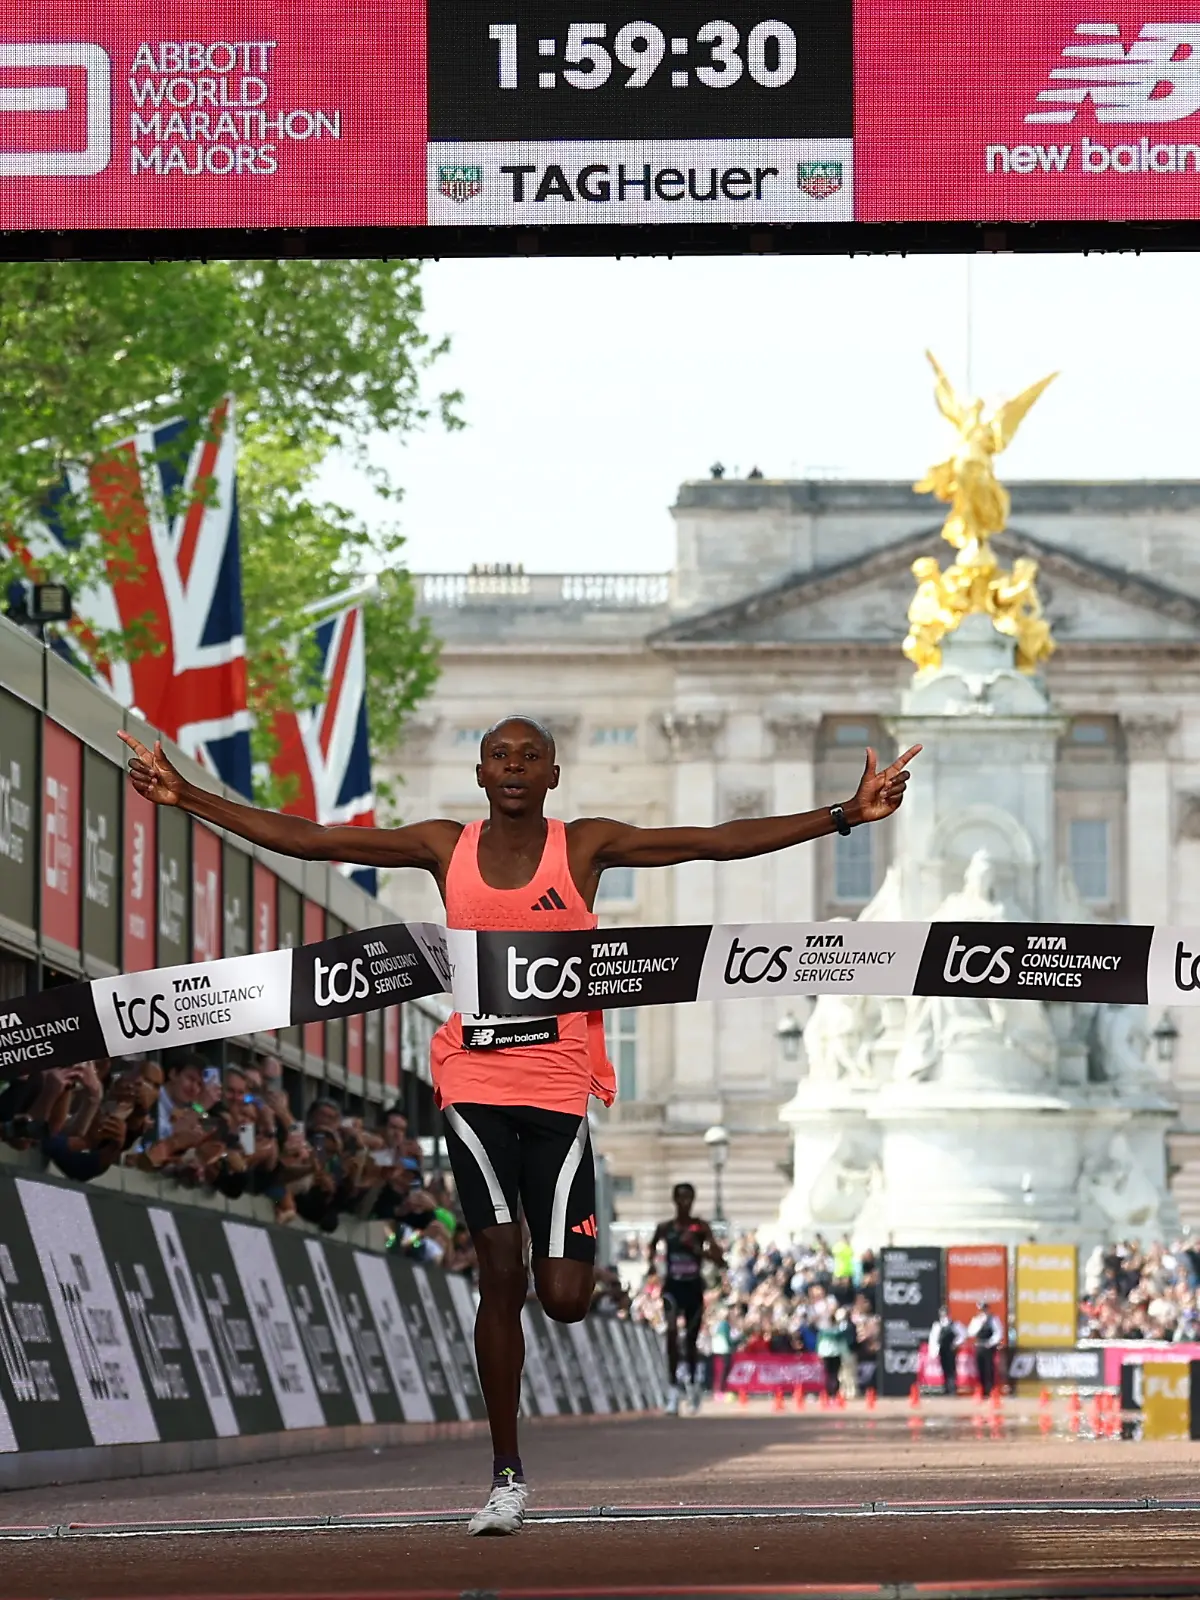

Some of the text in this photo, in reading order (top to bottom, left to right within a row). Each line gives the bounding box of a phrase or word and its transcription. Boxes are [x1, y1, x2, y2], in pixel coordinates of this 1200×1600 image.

[130, 41, 279, 74] ABBOTT
[488, 20, 797, 88] 1:59:30
[128, 76, 269, 108] WORLD
[130, 109, 341, 141] MARATHON
[131, 144, 279, 175] MAJORS
[985, 144, 1072, 174] new
[363, 941, 388, 957] TATA
[591, 942, 628, 958] TATA
[805, 935, 844, 948] TATA
[1027, 936, 1067, 950] TATA
[370, 953, 419, 975] CONSULTANCY
[589, 957, 680, 977] CONSULTANCY
[724, 937, 793, 985] tcs
[799, 951, 896, 965] CONSULTANCY
[943, 935, 1015, 984] tcs
[1021, 953, 1122, 971] CONSULTANCY
[314, 957, 370, 1007] tcs
[374, 972, 413, 994] SERVICES
[507, 945, 582, 1000] tcs
[793, 968, 855, 982] SERVICES
[1017, 971, 1082, 988] SERVICES
[172, 976, 211, 993] TATA
[587, 978, 643, 996] SERVICES
[174, 985, 264, 1012] CONSULTANCY
[112, 991, 170, 1039] tcs
[177, 1008, 231, 1031] SERVICES
[495, 1031, 550, 1045] new balance
